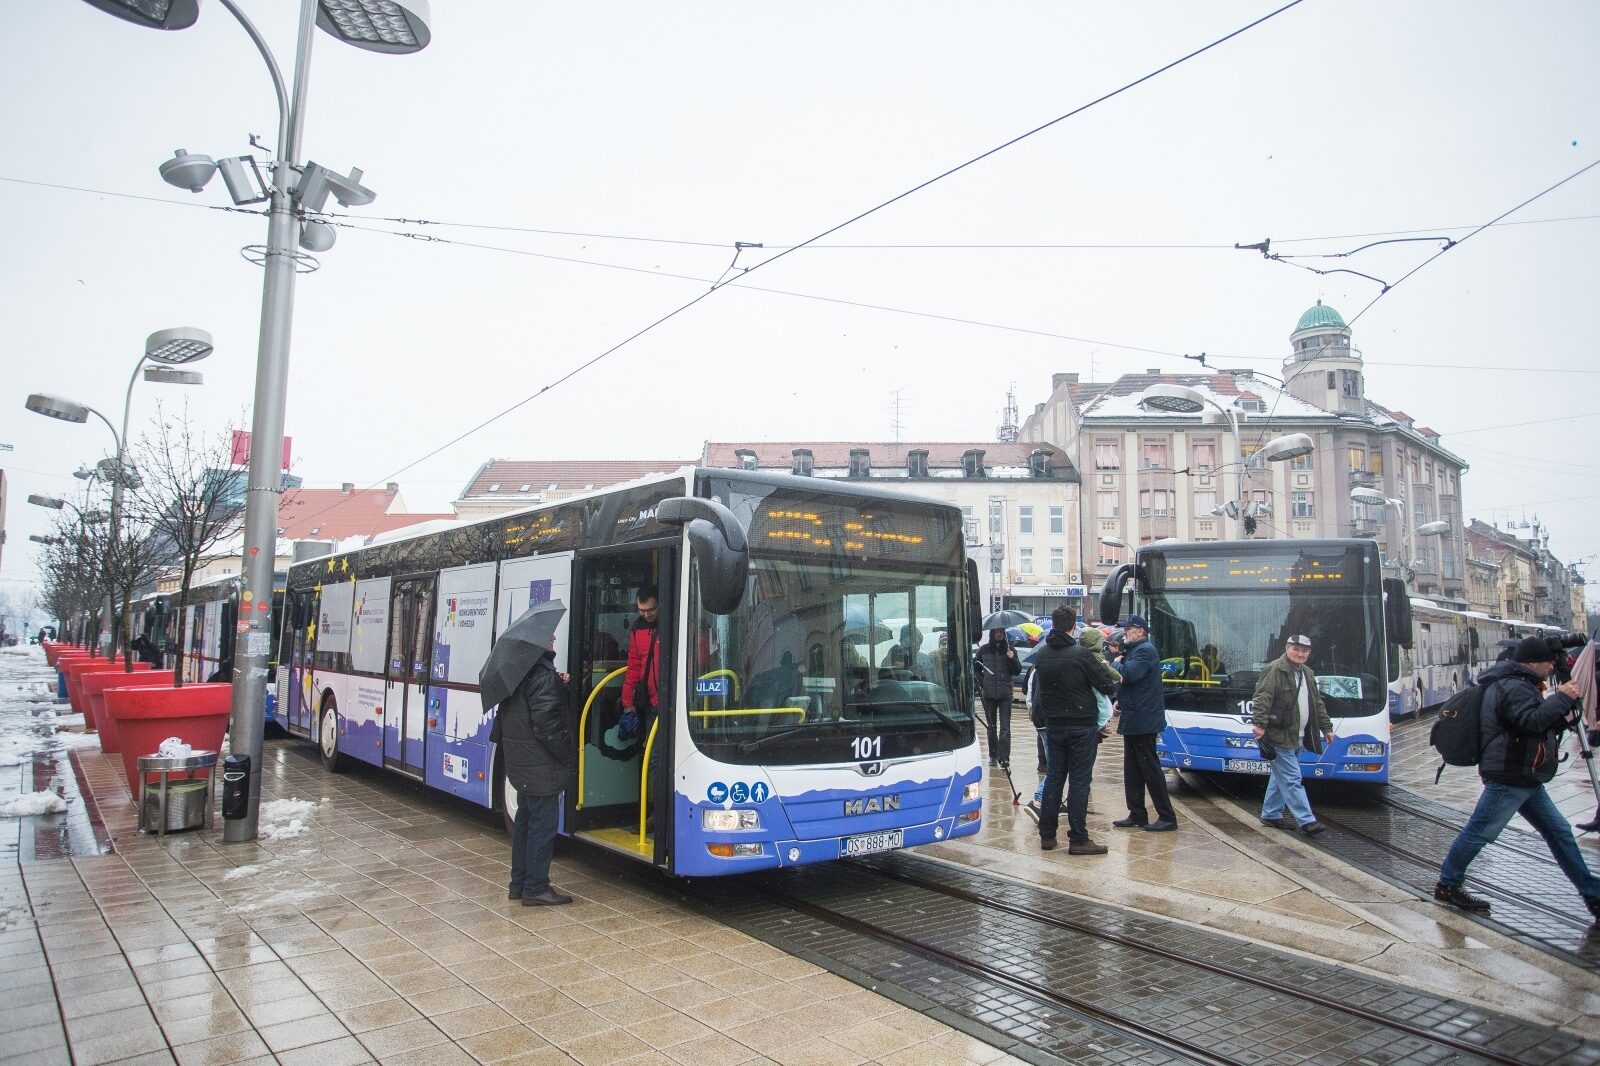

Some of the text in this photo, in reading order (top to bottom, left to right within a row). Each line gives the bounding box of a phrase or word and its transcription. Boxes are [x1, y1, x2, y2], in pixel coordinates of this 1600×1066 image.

[696, 682, 721, 692] ULAZ
[1237, 700, 1254, 714] 10
[851, 735, 881, 759] 101
[1225, 737, 1259, 749] MA
[844, 794, 901, 816] MAN
[847, 839, 860, 853] OS
[866, 833, 900, 850] 888-MO
